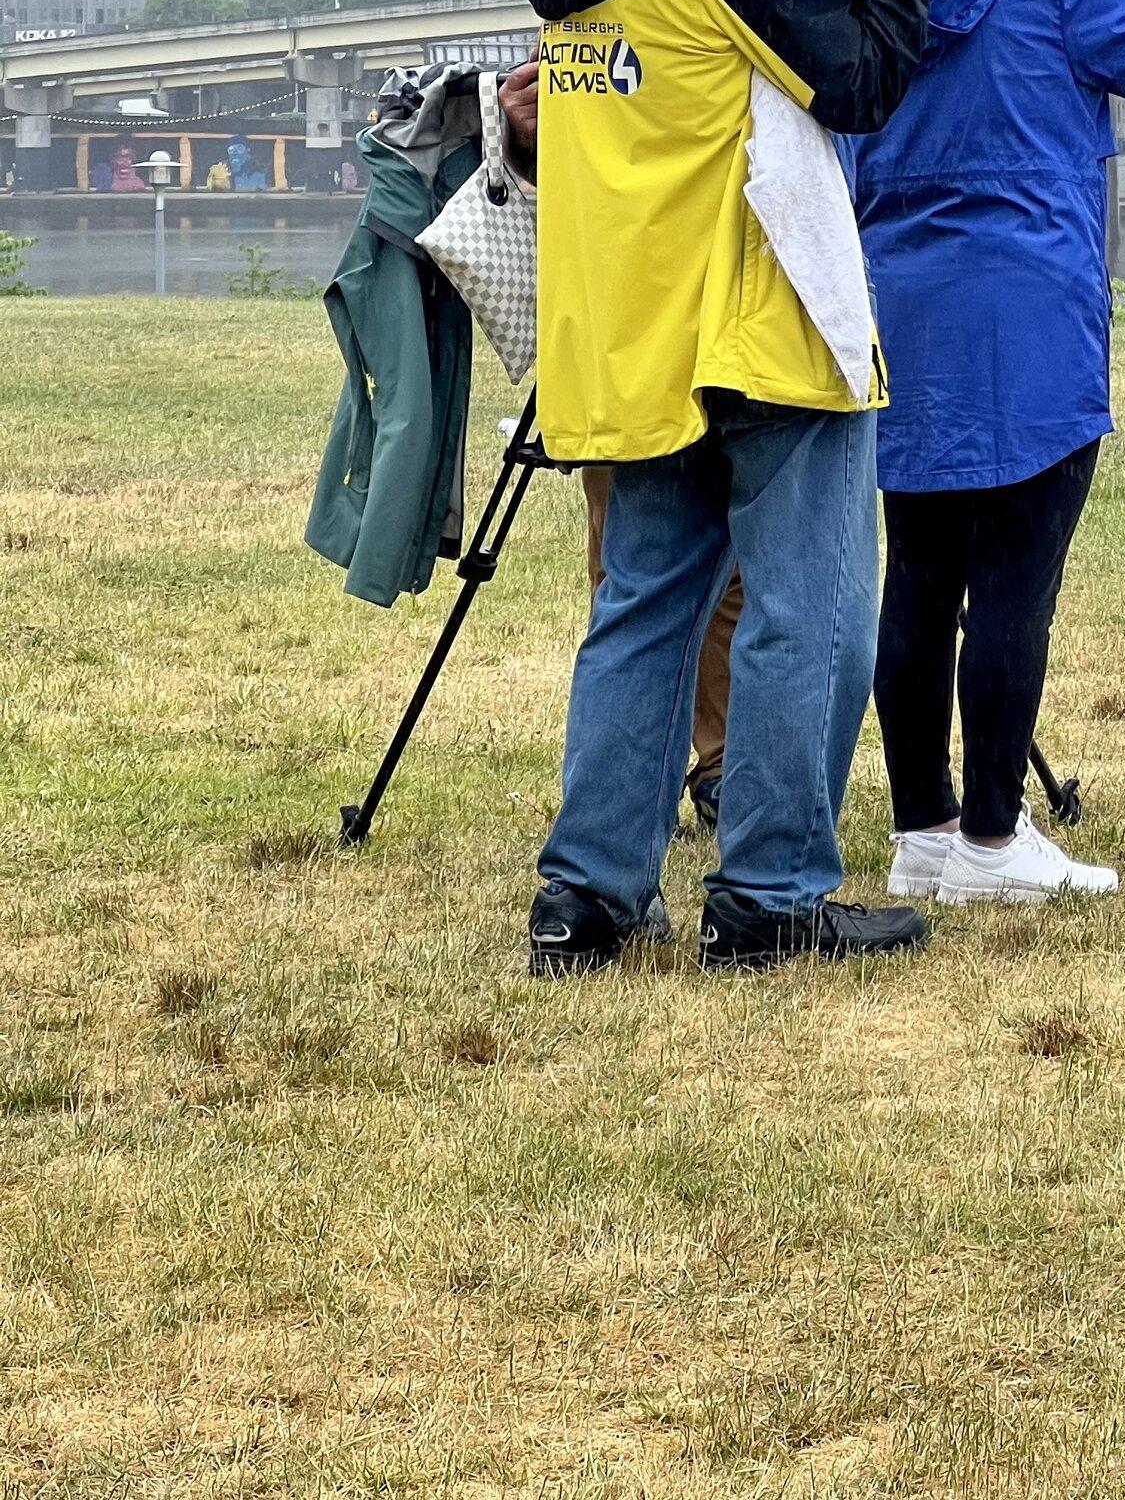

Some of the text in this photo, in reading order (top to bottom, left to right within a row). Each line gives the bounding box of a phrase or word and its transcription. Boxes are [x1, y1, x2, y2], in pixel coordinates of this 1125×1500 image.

[15, 29, 57, 42] KDKA
[540, 41, 606, 65] ACTION
[549, 68, 608, 94] NEWS
